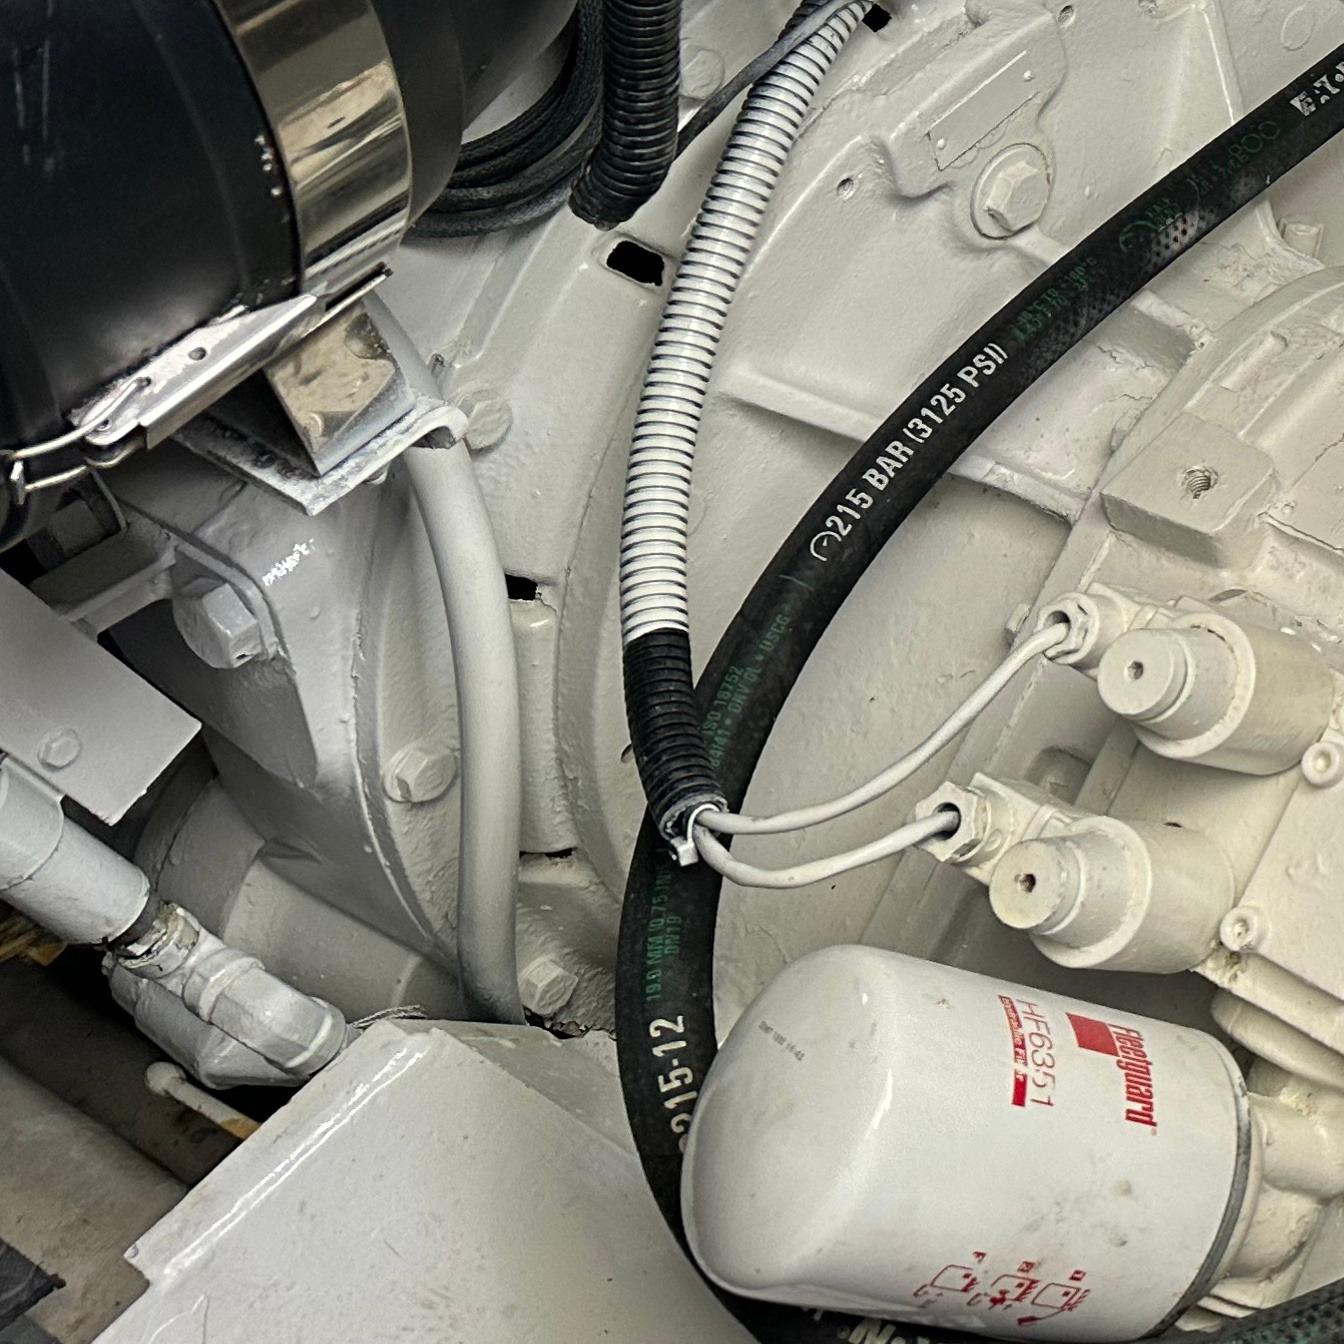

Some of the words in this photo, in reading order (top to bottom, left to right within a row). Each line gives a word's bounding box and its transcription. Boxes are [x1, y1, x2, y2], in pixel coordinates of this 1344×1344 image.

[823, 489, 874, 538] 215
[861, 440, 914, 492] BAR
[904, 383, 966, 447] (3125
[956, 342, 1010, 389] PSI)
[649, 1014, 695, 1154] 215-12
[1015, 998, 1056, 1107] HF6351
[1107, 1022, 1158, 1128] Fleetguard
